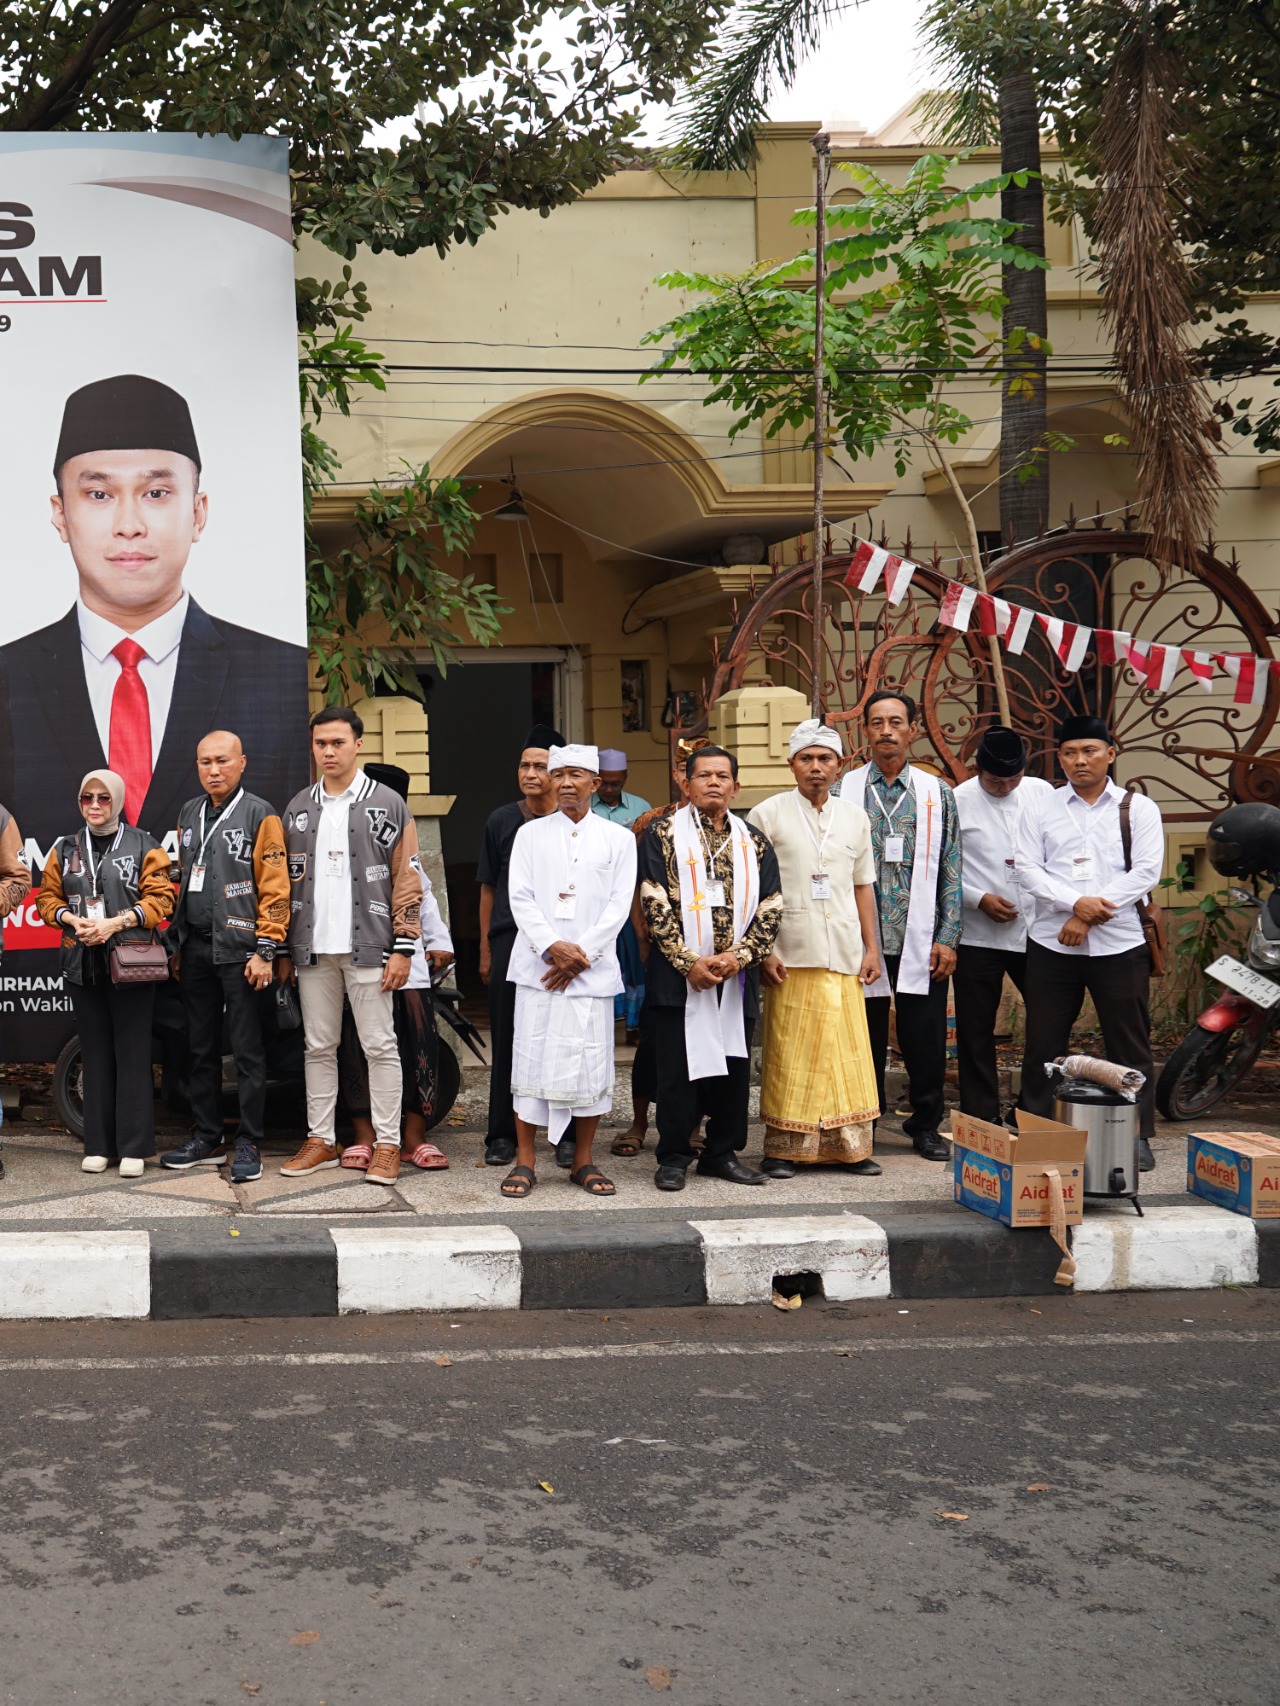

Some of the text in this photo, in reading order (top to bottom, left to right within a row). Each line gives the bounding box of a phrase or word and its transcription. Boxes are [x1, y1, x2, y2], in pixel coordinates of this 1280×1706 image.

[1218, 957, 1229, 966] S
[20, 995, 74, 1012] Wakil
[1197, 1157, 1236, 1185] Aidrat
[963, 1166, 998, 1195] Aidrat
[1020, 1185, 1074, 1199] Aidat
